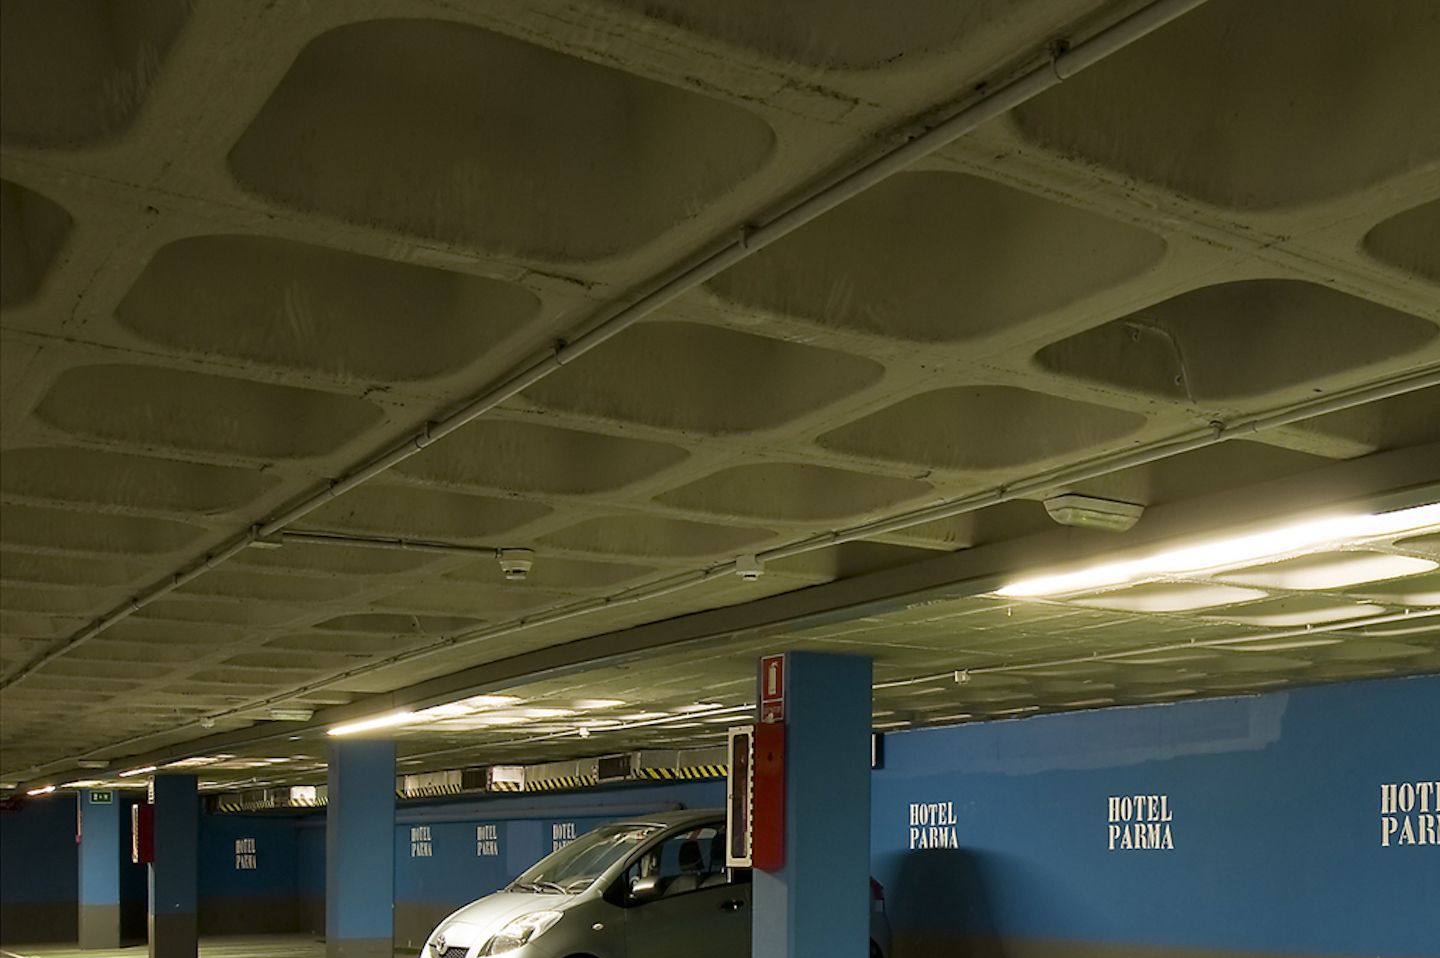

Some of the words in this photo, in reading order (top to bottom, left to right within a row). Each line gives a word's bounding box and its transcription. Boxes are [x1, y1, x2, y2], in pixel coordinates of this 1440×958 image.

[909, 802, 957, 826] HOTEL
[1108, 795, 1173, 822] HOTEL
[909, 826, 959, 850] PARMA
[1108, 824, 1174, 850] PARMA
